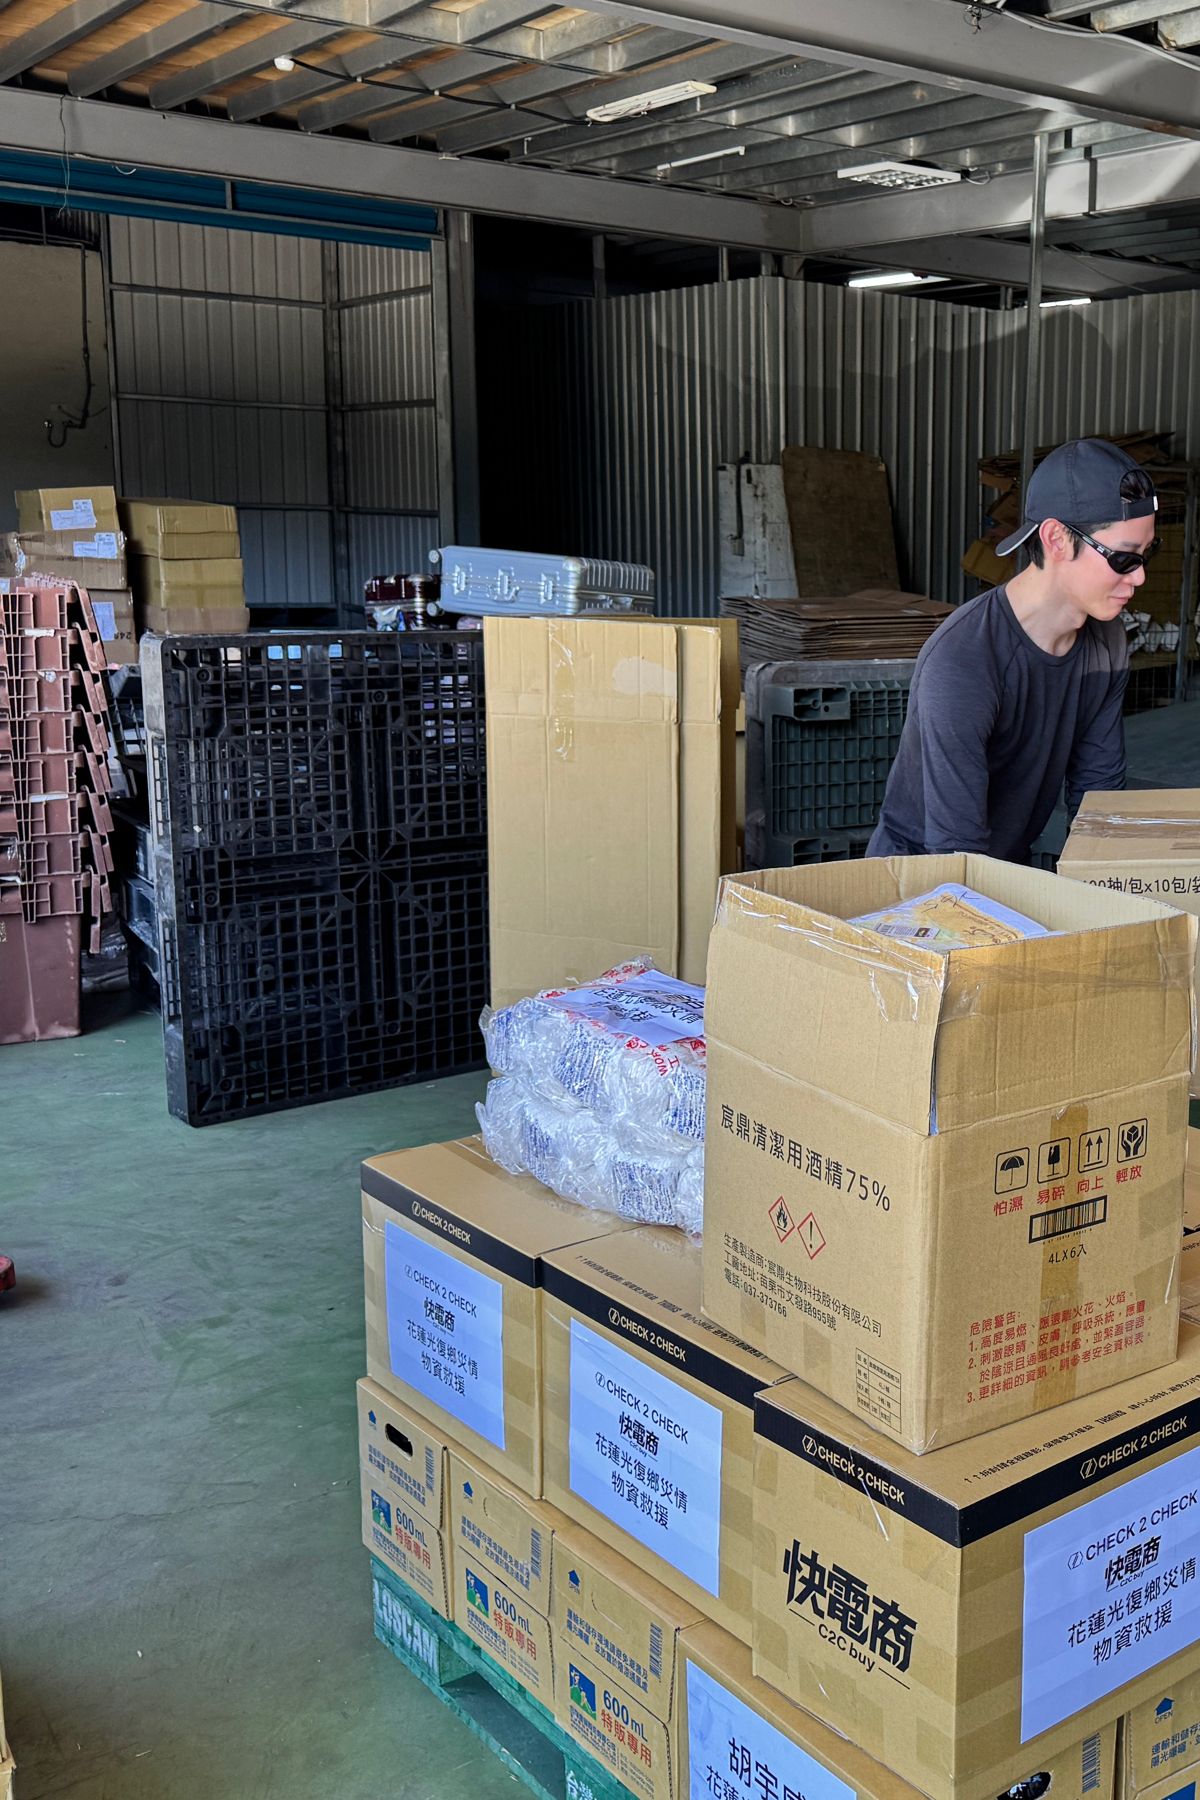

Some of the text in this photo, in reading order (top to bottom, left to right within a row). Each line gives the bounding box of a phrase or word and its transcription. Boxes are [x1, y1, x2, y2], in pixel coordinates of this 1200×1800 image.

[721, 1104, 890, 1212] 宸鼎清潔用酒精75%
[994, 1165, 1142, 1216] 怕濕 易碎 向上 輕放
[421, 1207, 442, 1228] CHECK
[448, 1223, 471, 1245] CHECK
[414, 1270, 477, 1318] CHECK 2 CHECK
[424, 1297, 455, 1333] 快電商
[407, 1319, 478, 1380] 花蓮光復鄉災情
[620, 1316, 649, 1341] CHECK
[650, 1332, 656, 1345] 2
[656, 1335, 687, 1363] CHECK
[421, 1350, 466, 1397] 物資救援
[607, 1379, 689, 1445] CHECK 2 CHECK
[618, 1411, 660, 1456] 快電商
[1098, 1416, 1188, 1470] CHECK 2 CHECK
[595, 1432, 688, 1514] 花蓮光復鄉災情
[611, 1470, 669, 1530] 物資救援
[818, 1445, 906, 1505] CHECK 2 CHECK
[1086, 1489, 1198, 1561] CHECK 2 CHECK
[1105, 1535, 1162, 1589] 快電商
[373, 1579, 439, 1679] LOSCAM
[782, 1538, 918, 1673] 快電商
[1067, 1557, 1196, 1648] 花蓮光復鄉災情
[493, 1610, 537, 1661] 特販專用
[818, 1623, 876, 1672] C2C buy
[1093, 1600, 1173, 1666] 物資救援
[601, 1709, 652, 1768] 特販專用
[1155, 1710, 1174, 1724] OPEN
[706, 1765, 745, 1800] 花蓮
